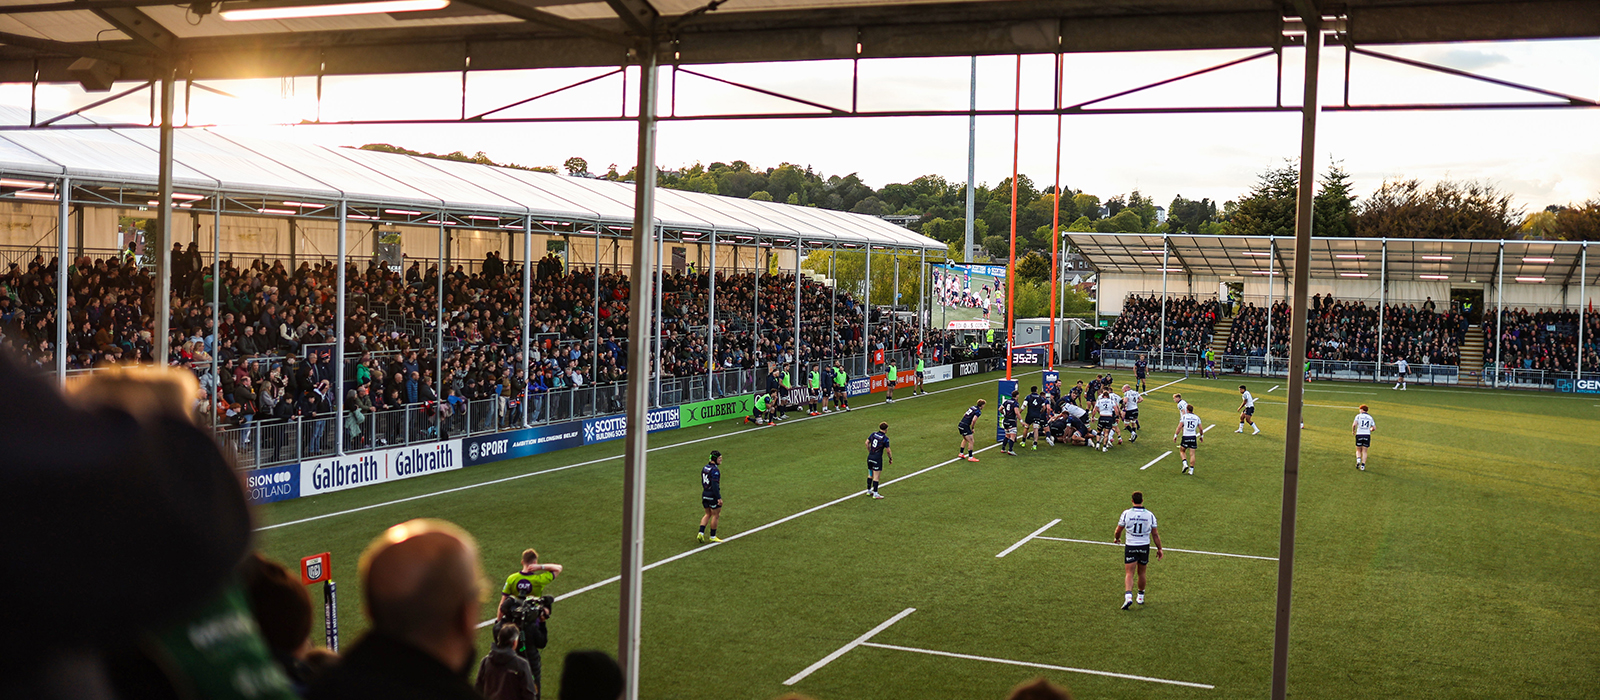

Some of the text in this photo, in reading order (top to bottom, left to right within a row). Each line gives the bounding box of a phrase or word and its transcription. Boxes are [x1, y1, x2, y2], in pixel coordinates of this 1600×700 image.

[1013, 353, 1038, 363] 35:25
[960, 362, 978, 376] macron
[788, 387, 810, 406] AIRWA
[646, 409, 679, 424] SCOTTISH
[701, 402, 736, 419] GILBERT
[595, 417, 627, 432] SCOTTIS
[646, 420, 679, 431] BUILDING SOCIETY
[596, 429, 627, 440] BUILDING SOCIE
[480, 439, 508, 457] SPORT
[512, 439, 537, 448] AMBITION
[538, 434, 562, 443] BELONGING
[872, 439, 878, 448] 9
[396, 444, 453, 476] Galbraith
[313, 455, 378, 490] Galbraith
[246, 474, 272, 488] ISION
[246, 484, 291, 500] COTLAND
[1133, 523, 1142, 533] 11
